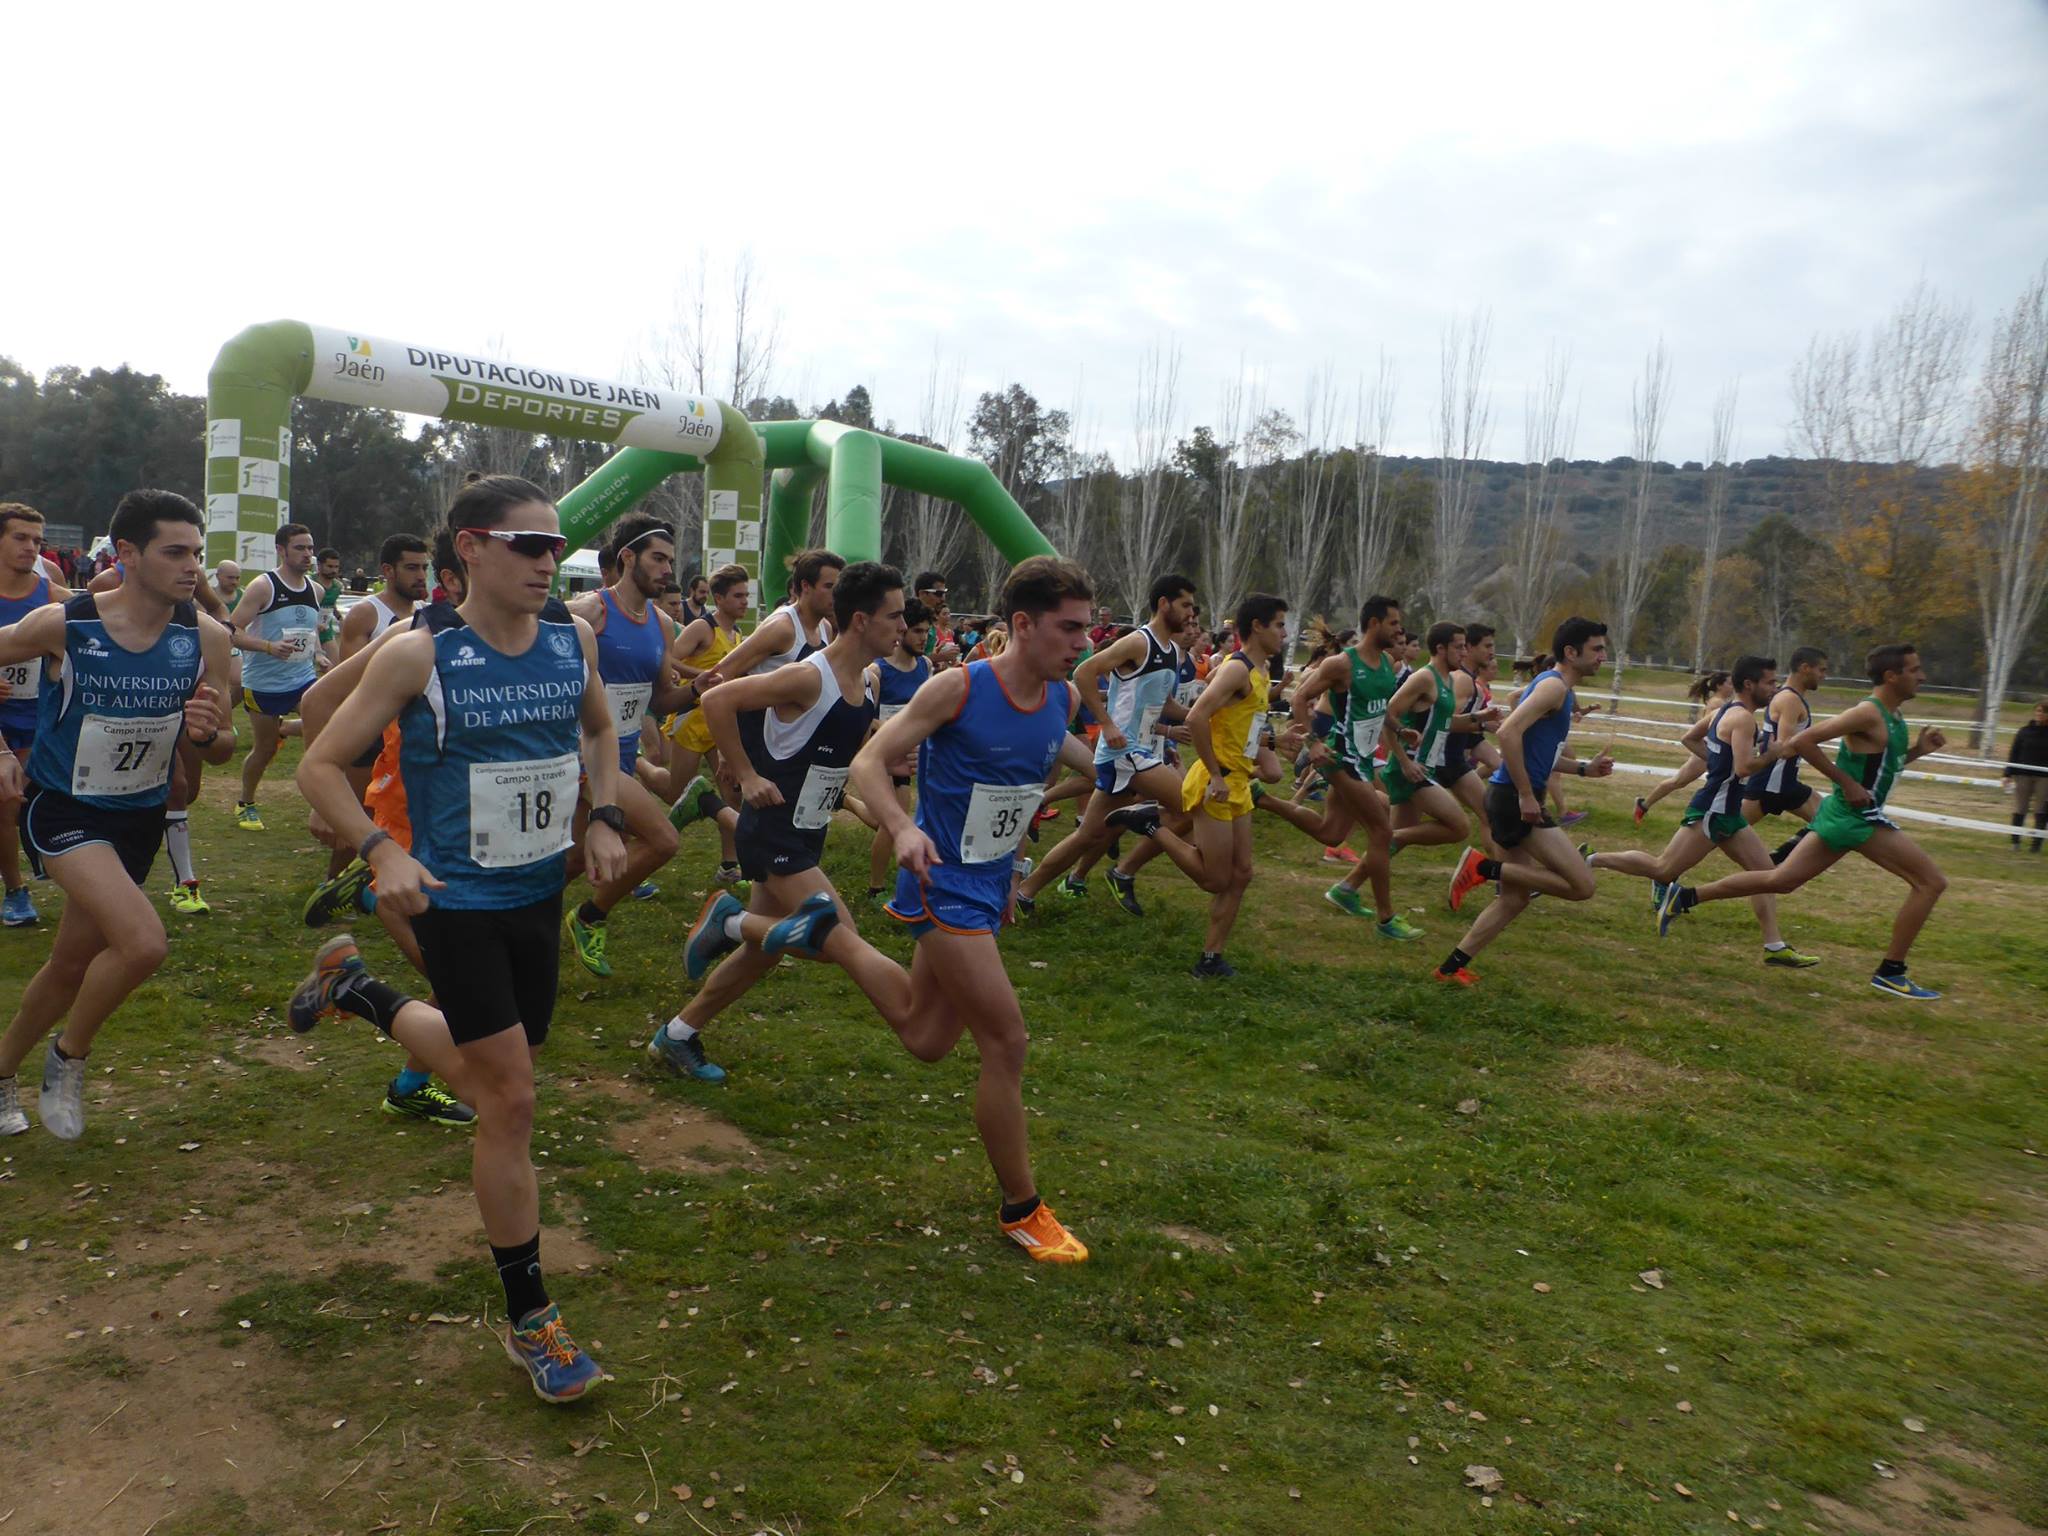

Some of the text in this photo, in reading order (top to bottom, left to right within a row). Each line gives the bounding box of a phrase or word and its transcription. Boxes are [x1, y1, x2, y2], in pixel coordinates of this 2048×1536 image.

[335, 353, 385, 382] Jaén
[407, 348, 564, 394] DIPUTACIÓN
[569, 378, 601, 400] DE
[606, 384, 661, 411] JAÉN
[456, 383, 622, 428] DEPORTES
[678, 416, 714, 439] Jaén
[450, 657, 487, 667] VIATOR
[6, 666, 28, 686] 28
[75, 671, 192, 691] UNIVERSIDAD
[82, 692, 181, 709] DE ALMERÍA
[451, 680, 582, 705] UNIVERSIDAD
[464, 700, 576, 728] DE ALMERÍA
[622, 699, 638, 721] 33
[103, 725, 135, 736] Campo
[113, 740, 152, 772] 27
[495, 774, 531, 786] Campo
[516, 790, 552, 833] 18
[992, 807, 1023, 839] 35
